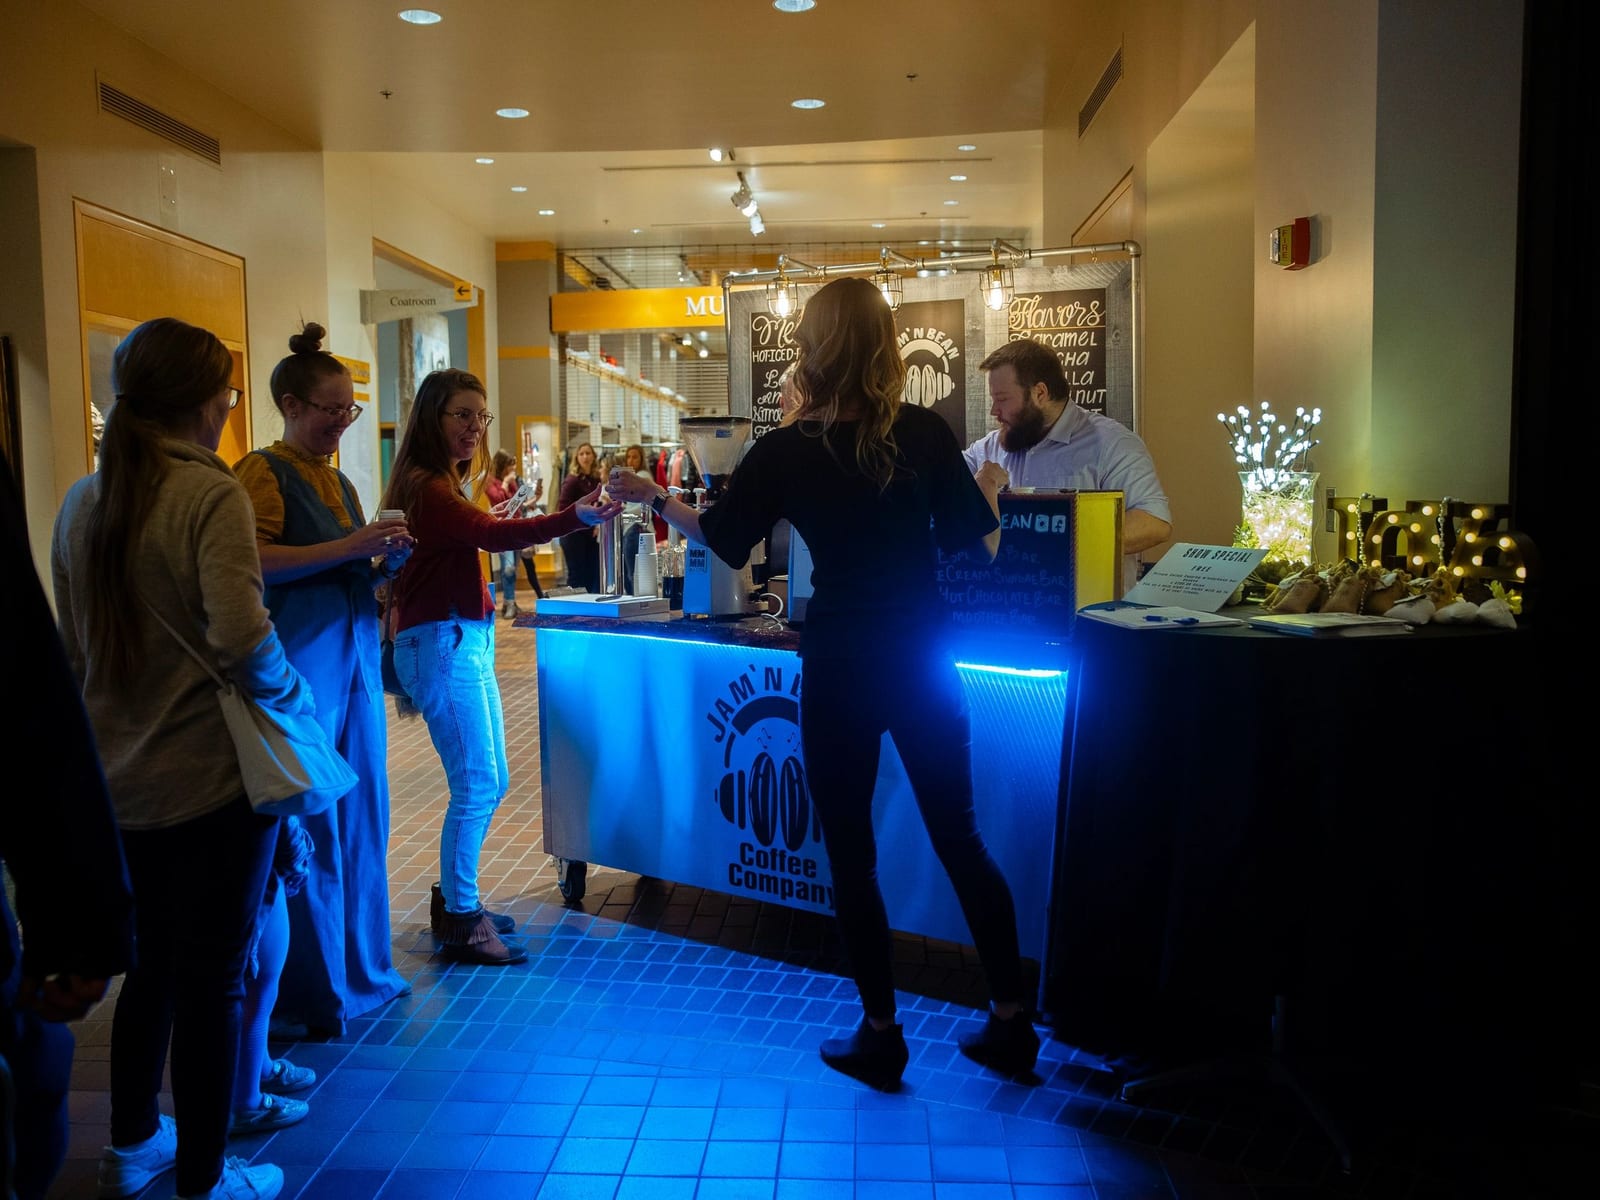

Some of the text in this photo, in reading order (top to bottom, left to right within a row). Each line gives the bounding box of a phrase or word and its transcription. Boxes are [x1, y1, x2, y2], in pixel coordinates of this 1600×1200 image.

[390, 296, 437, 307] Coatroom
[1009, 294, 1106, 330] Flavors
[926, 327, 960, 360] BEAN
[1182, 547, 1252, 563] SHOW SPECIAL
[1191, 565, 1212, 573] FREE
[967, 585, 1032, 606] CHOCOLATE
[740, 842, 817, 878] Coffee
[728, 863, 832, 909] Company
